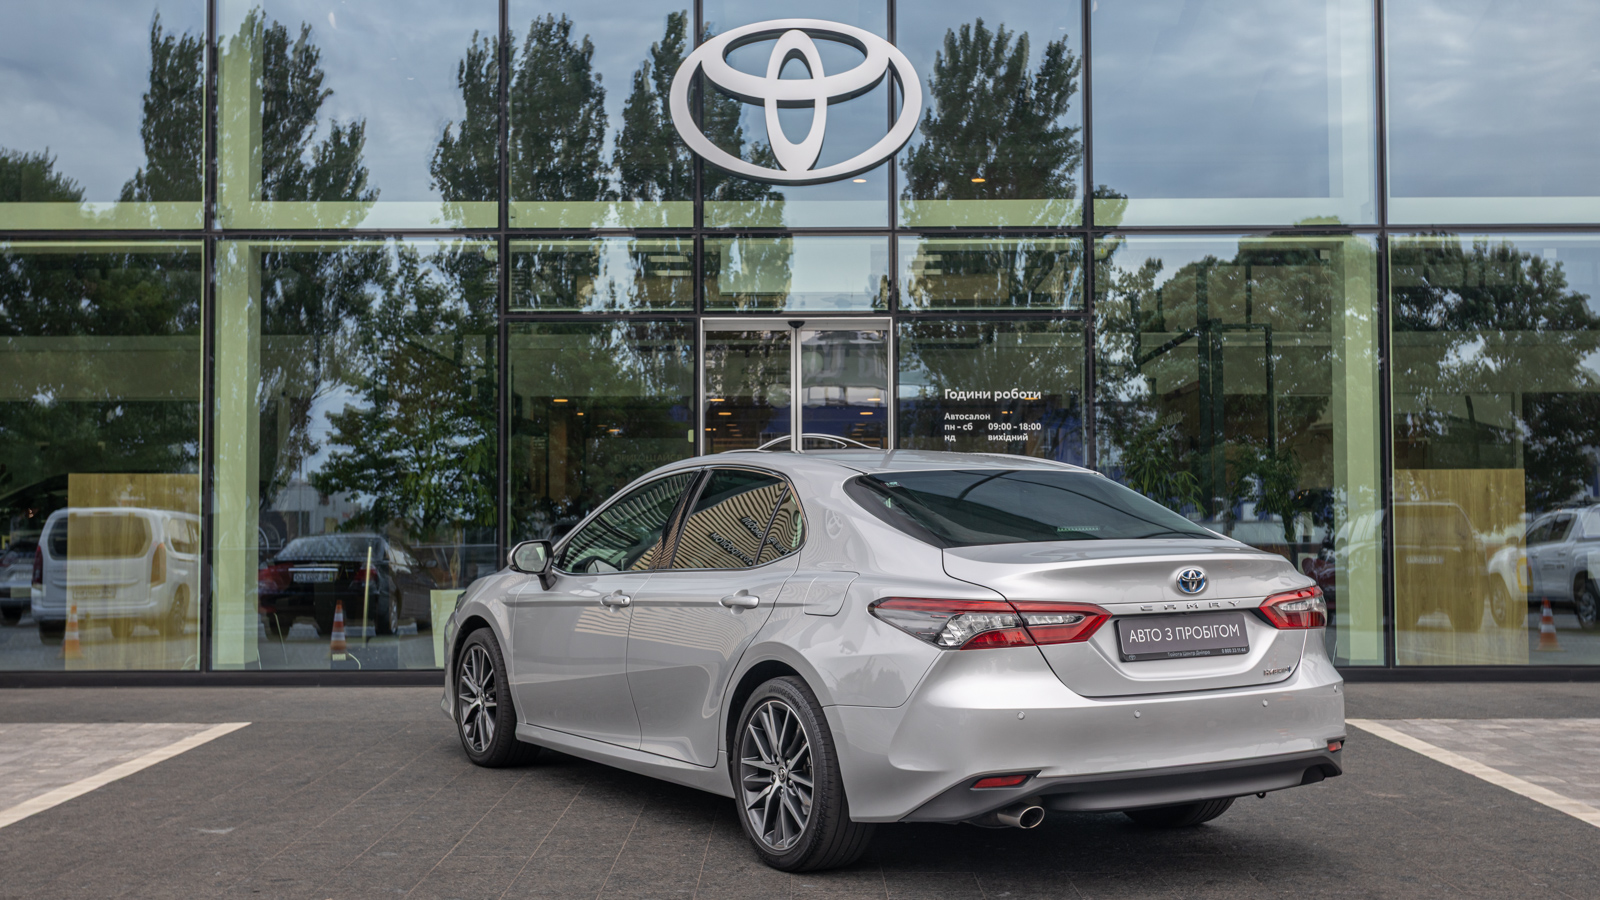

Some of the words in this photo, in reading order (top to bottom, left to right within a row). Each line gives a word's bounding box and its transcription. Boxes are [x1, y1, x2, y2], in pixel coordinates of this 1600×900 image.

[944, 388, 992, 402] Години
[994, 387, 1042, 402] роботи
[944, 412, 991, 420] Автосалон
[962, 422, 973, 431] сб
[988, 422, 1012, 431] 09:00
[1019, 422, 1042, 431] 18:00
[944, 434, 957, 442] нд
[988, 432, 1029, 442] вихідний
[1140, 600, 1240, 612] CAMRY
[1129, 628, 1162, 643] АВТО
[1165, 627, 1173, 641] З
[1175, 623, 1240, 640] ПРОБІГОМ
